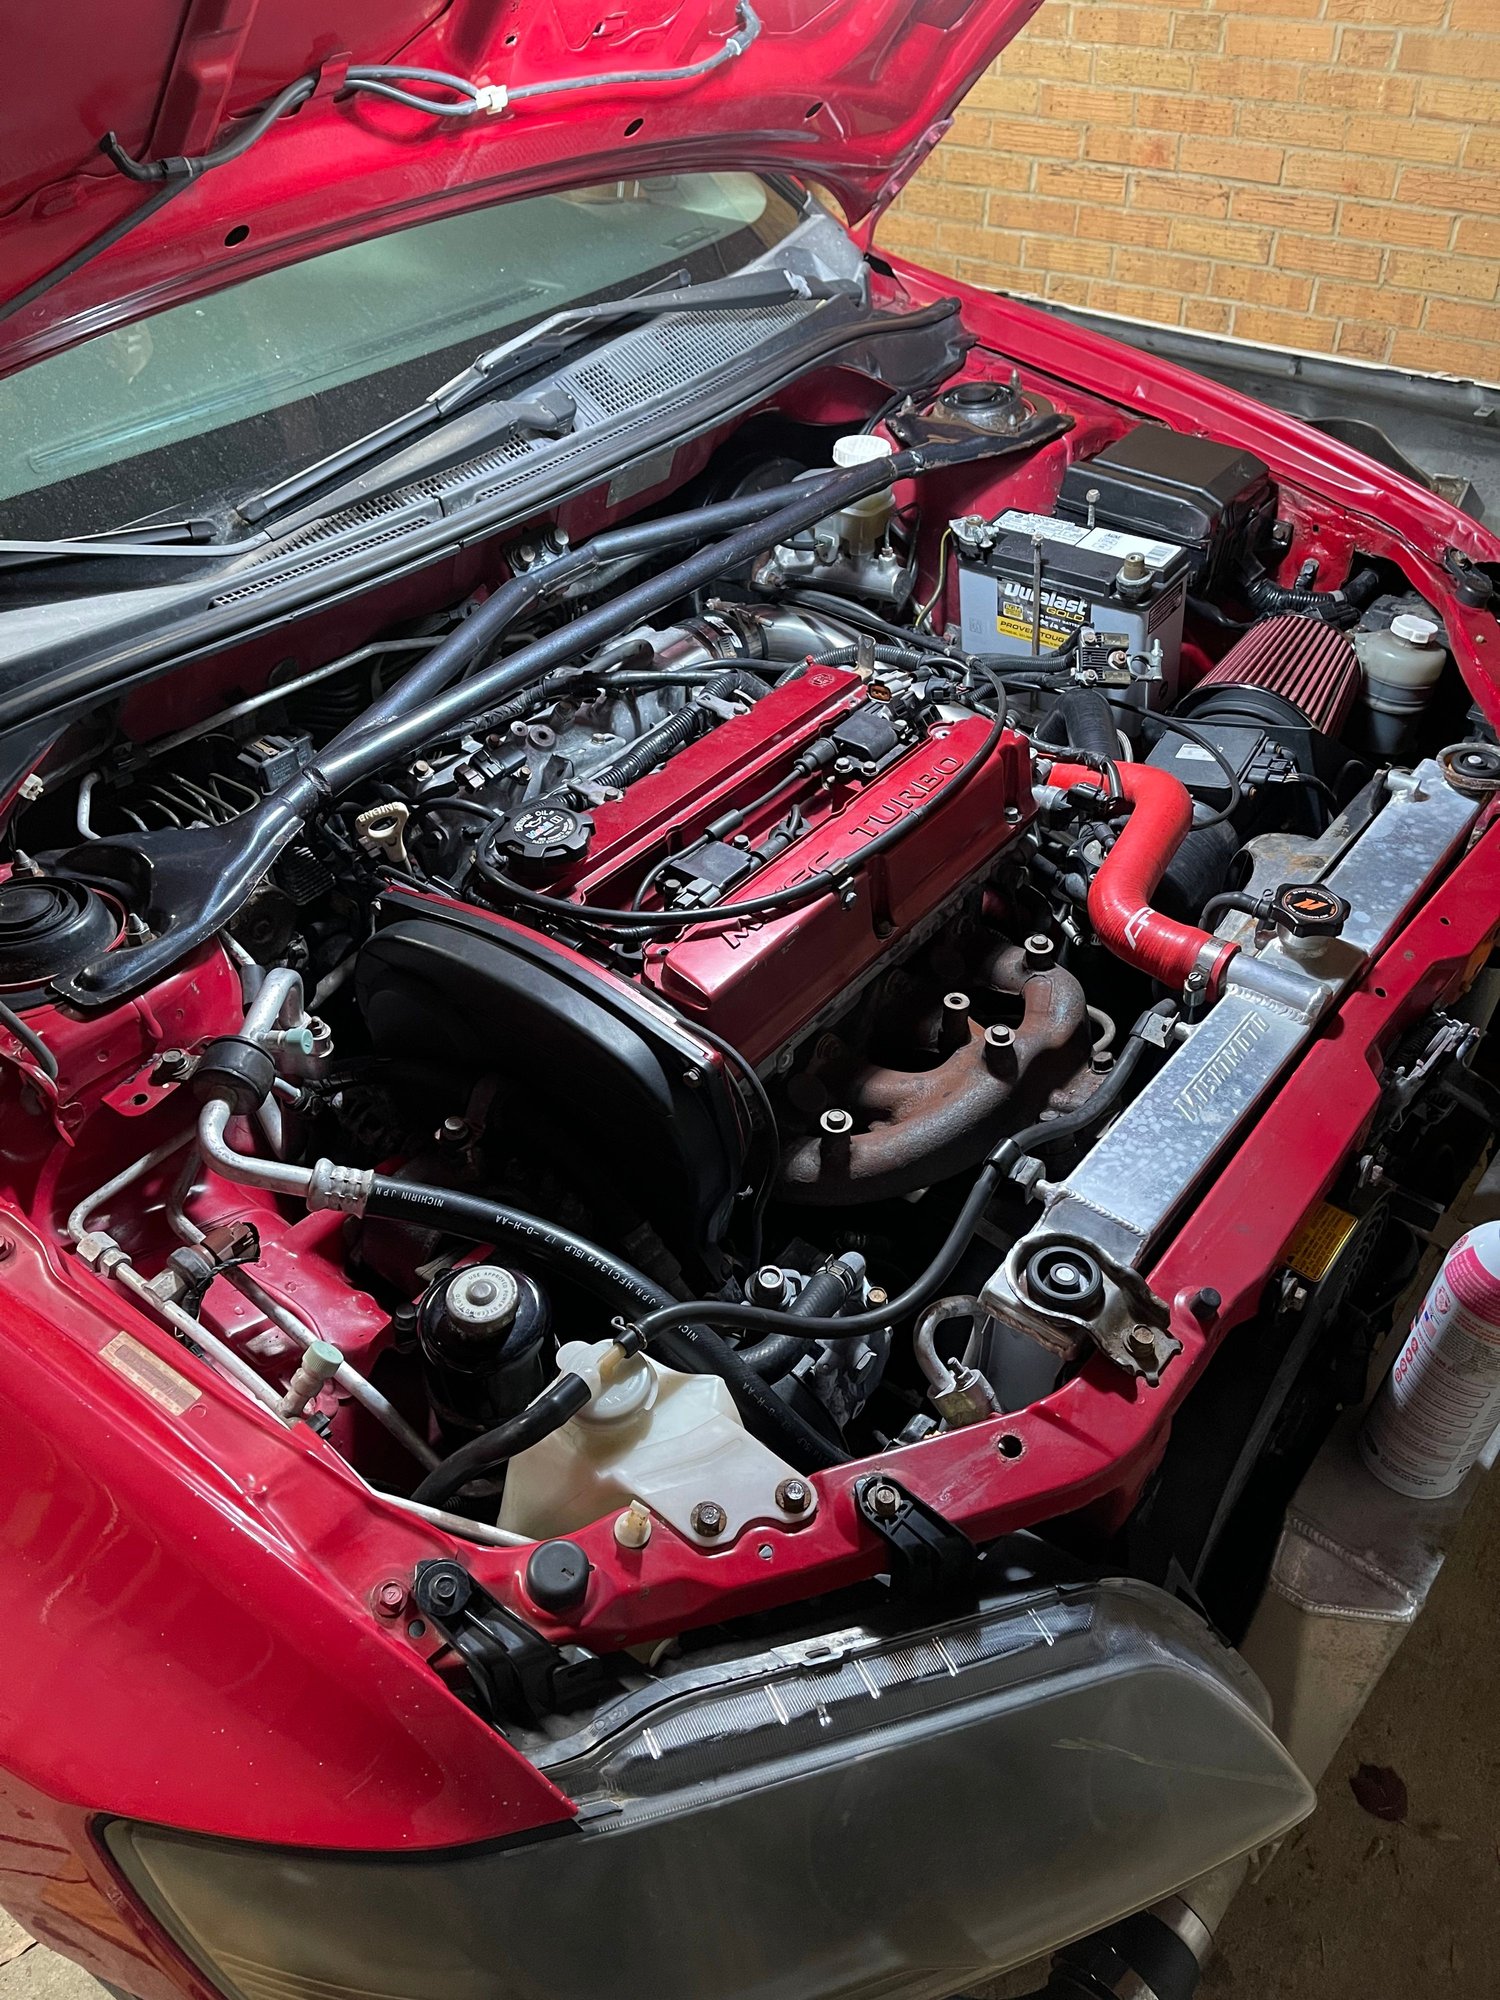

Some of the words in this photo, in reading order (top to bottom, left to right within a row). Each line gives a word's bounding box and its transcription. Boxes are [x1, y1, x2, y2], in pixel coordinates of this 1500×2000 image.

[1046, 606, 1085, 622] GOLD
[1040, 631, 1066, 644] TOUG
[849, 755, 964, 839] TURBO
[358, 803, 401, 823] ENGINE
[1173, 1010, 1270, 1122] MISHIMOTO
[375, 1186, 397, 1197] JPN
[400, 1191, 444, 1208] NICHIRIN
[635, 1287, 657, 1305] JPN
